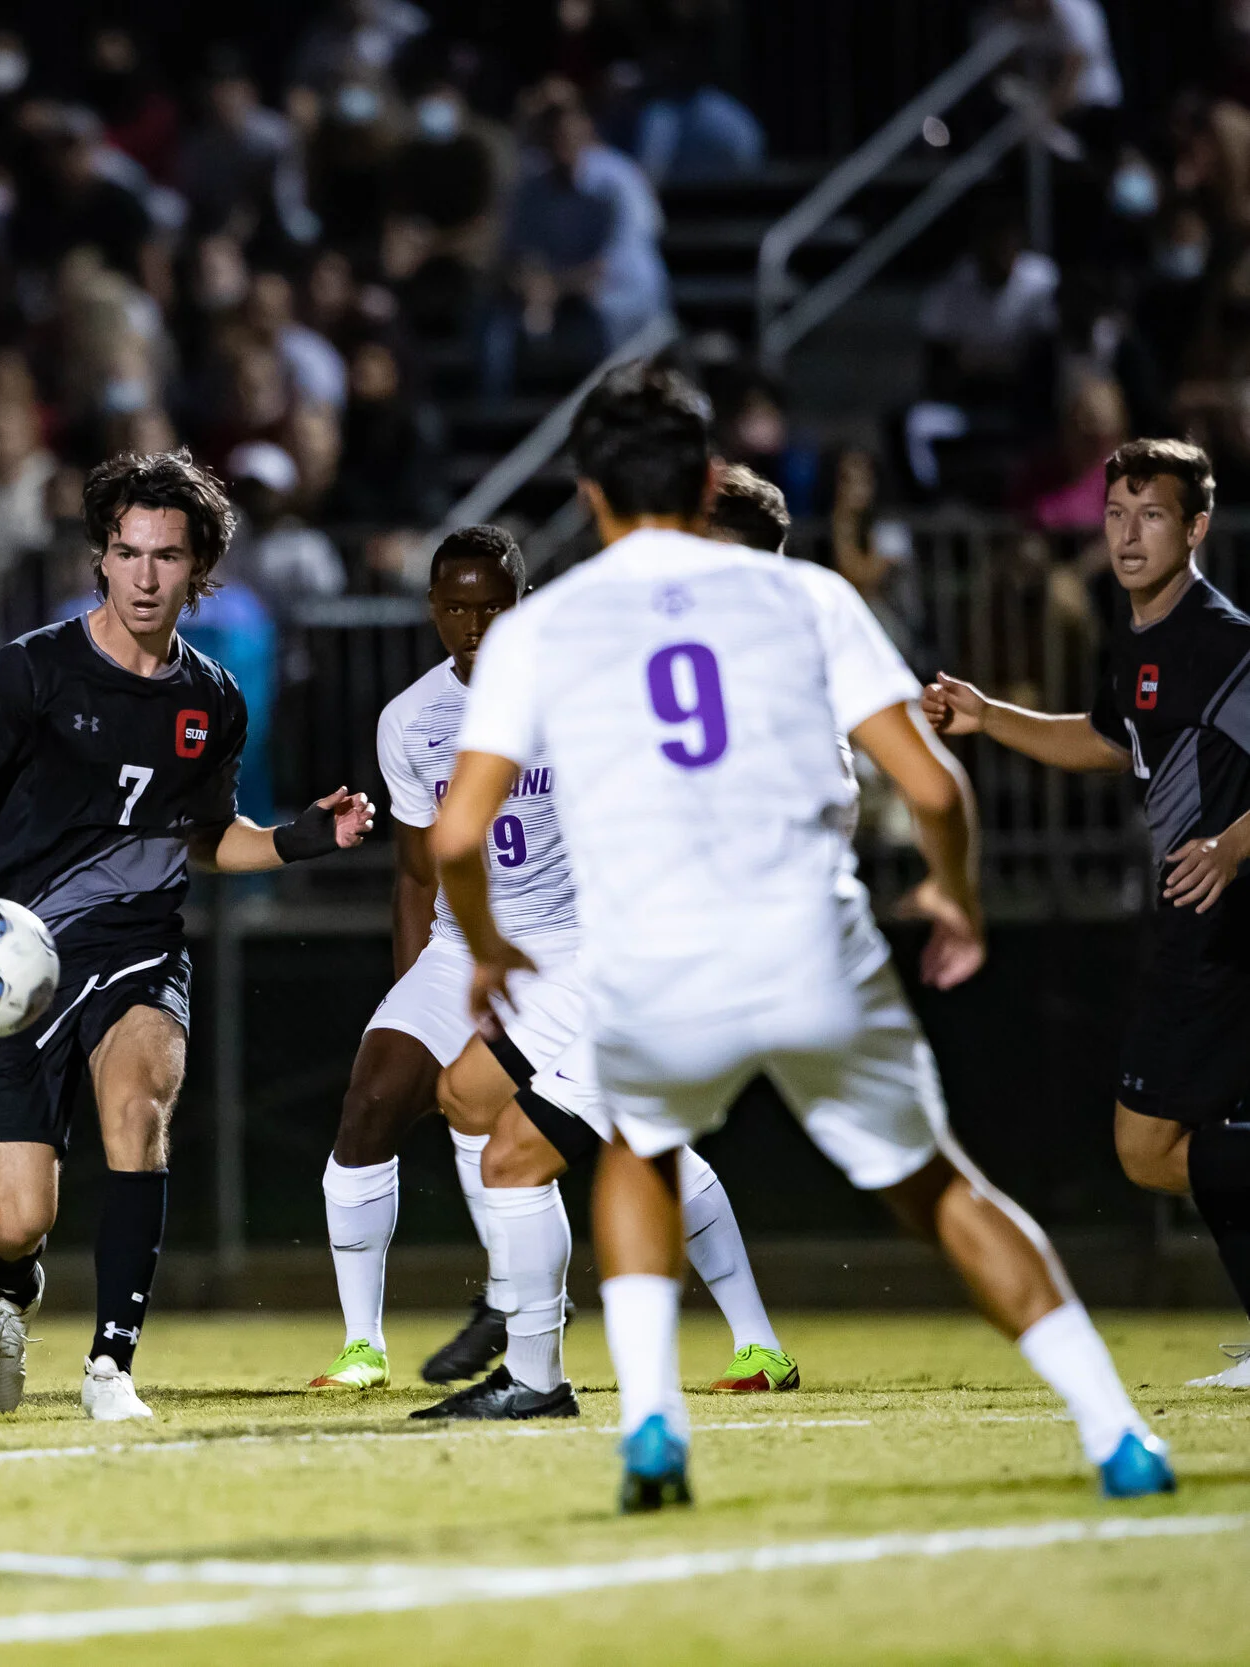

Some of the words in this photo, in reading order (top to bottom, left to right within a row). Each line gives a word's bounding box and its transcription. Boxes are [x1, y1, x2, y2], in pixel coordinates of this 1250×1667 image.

[648, 642, 728, 767] 9
[118, 764, 154, 826] 7
[493, 815, 527, 868] 9
